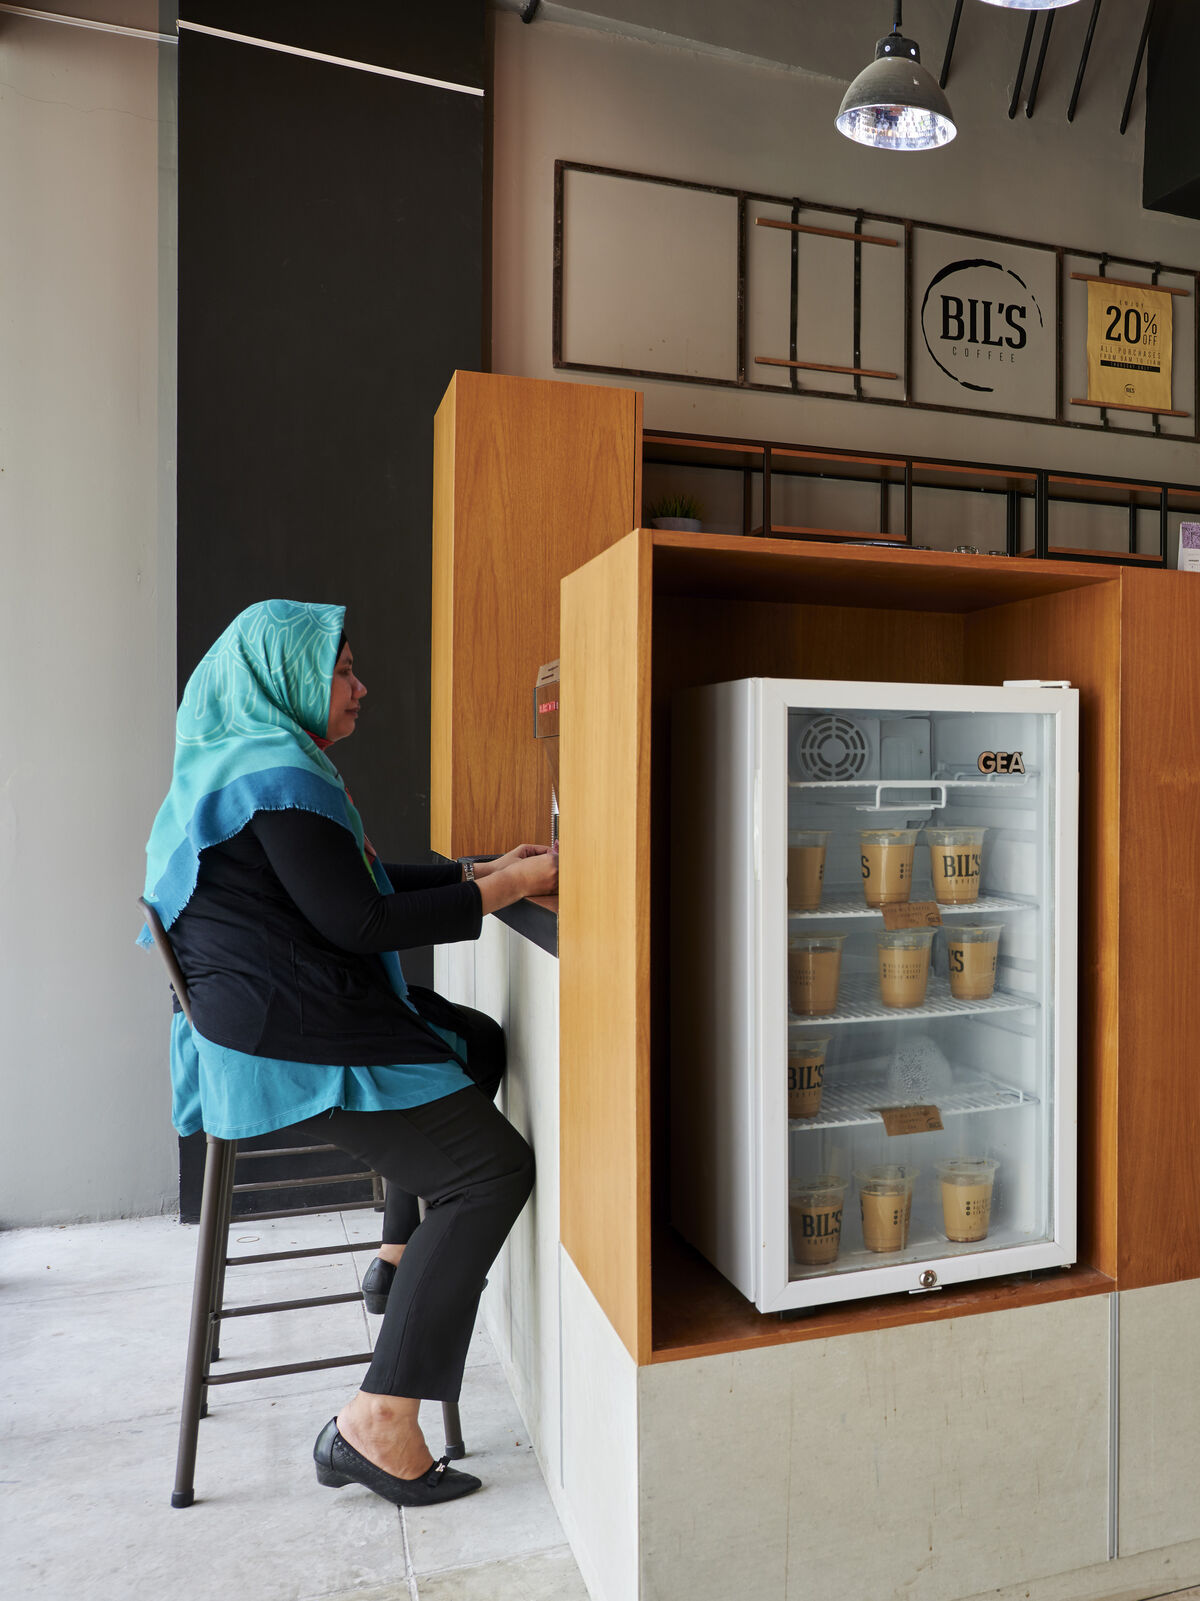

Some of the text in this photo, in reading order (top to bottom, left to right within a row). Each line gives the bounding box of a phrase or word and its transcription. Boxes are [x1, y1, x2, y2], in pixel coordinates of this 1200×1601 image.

[1119, 299, 1145, 308] ENJOY
[940, 294, 1027, 349] BIL'S
[1105, 305, 1158, 344] 20%
[1142, 334, 1157, 346] OFF
[952, 346, 1015, 363] COFFEE
[1100, 345, 1161, 360] ALL PURCHASES
[1100, 353, 1117, 361] FROM
[978, 751, 1025, 774] GEA
